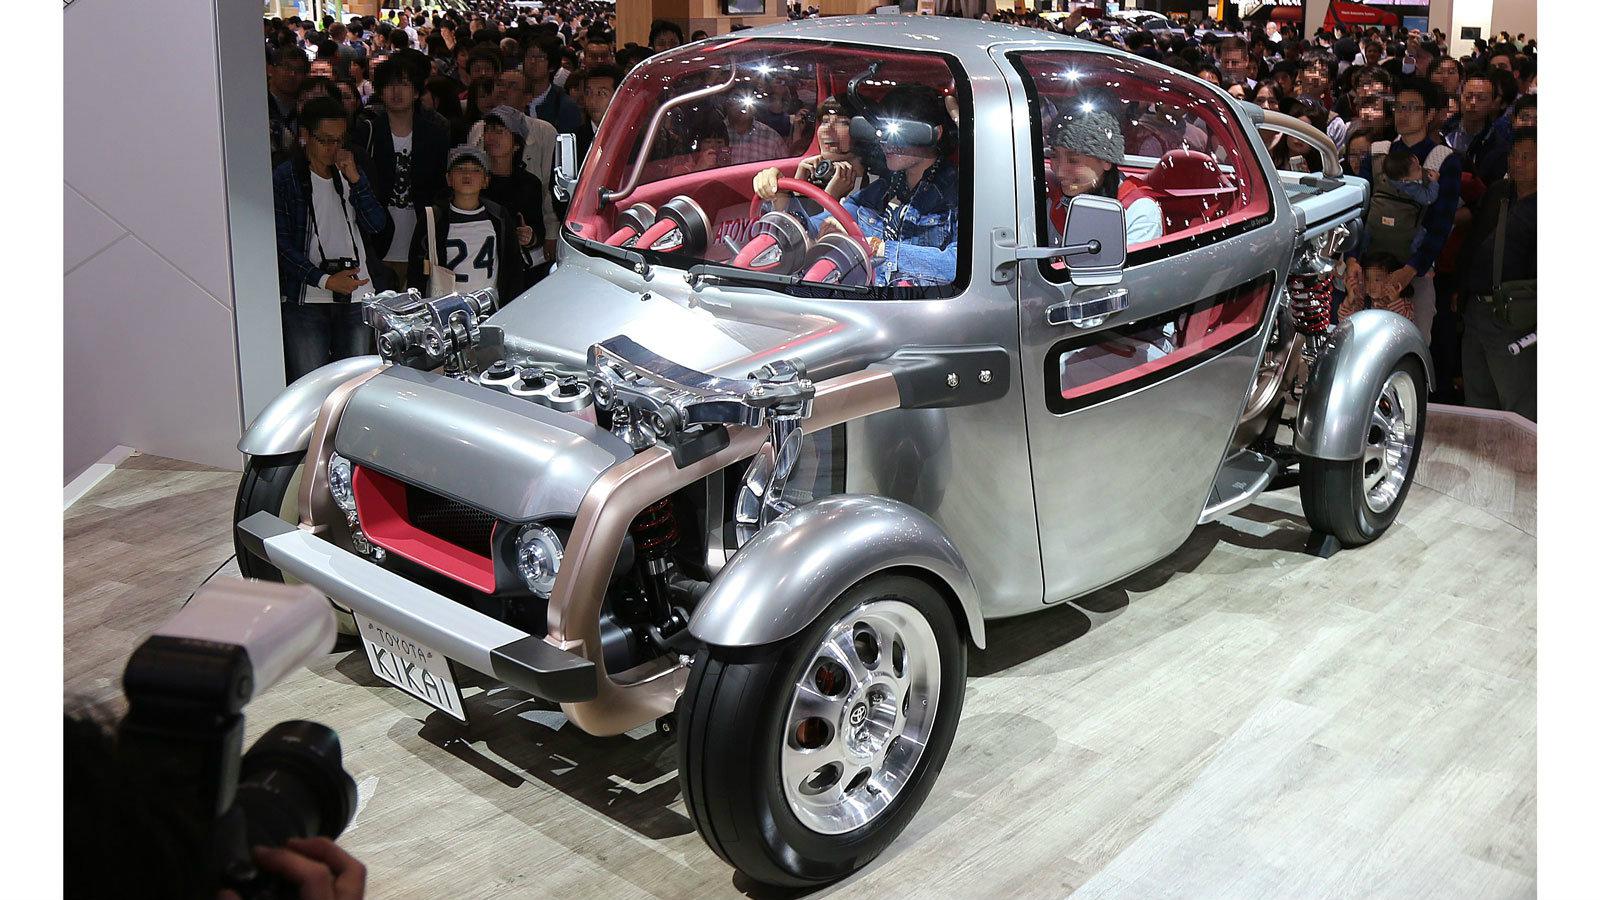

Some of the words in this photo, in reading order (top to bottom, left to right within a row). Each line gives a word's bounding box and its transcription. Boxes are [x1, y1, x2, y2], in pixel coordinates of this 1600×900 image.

[445, 235, 496, 283] 24
[376, 627, 428, 664] TOYOTA
[371, 642, 453, 710] KIKAI
